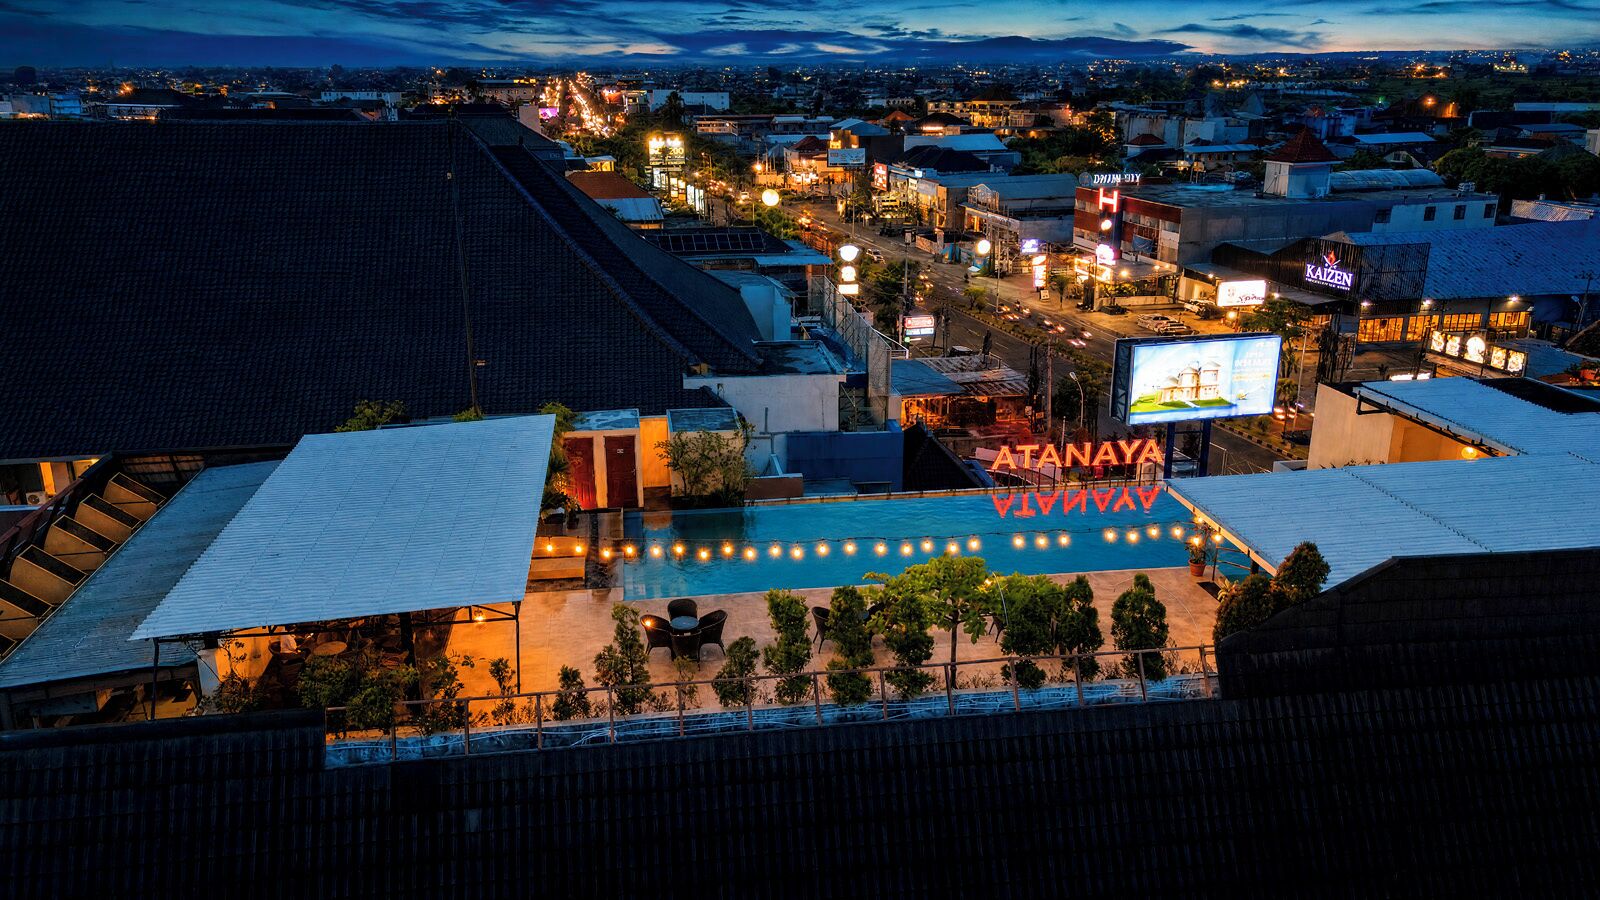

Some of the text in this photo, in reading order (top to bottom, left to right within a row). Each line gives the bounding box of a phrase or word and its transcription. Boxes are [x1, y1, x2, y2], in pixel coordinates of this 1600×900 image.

[1098, 187, 1119, 213] H
[1305, 263, 1353, 287] KAIZEN
[991, 439, 1163, 470] ATANAYA
